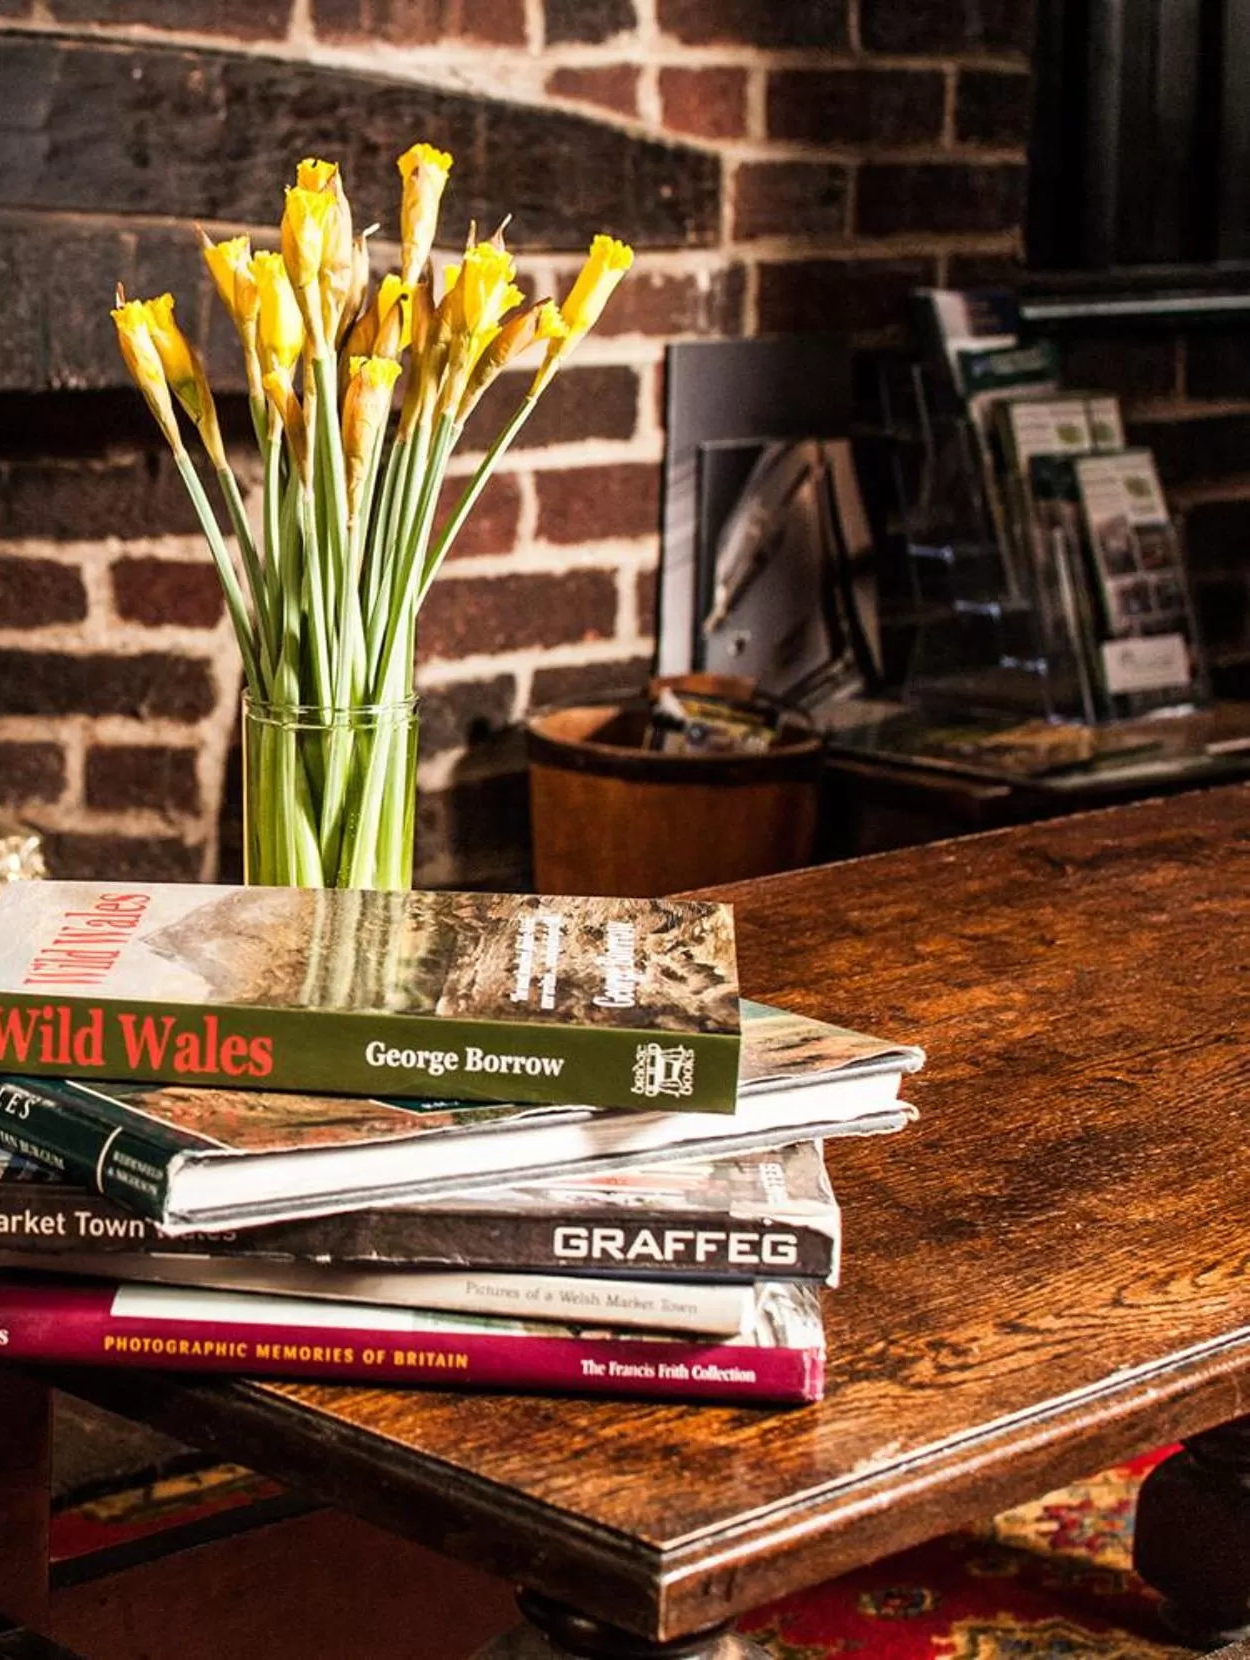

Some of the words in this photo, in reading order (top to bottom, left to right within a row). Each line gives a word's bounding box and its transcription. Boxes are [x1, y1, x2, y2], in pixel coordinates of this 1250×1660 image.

[53, 893, 151, 944] Wales
[23, 949, 121, 984] Wild
[118, 1013, 274, 1077] Wales
[365, 1041, 459, 1077] George
[464, 1047, 565, 1077] Borrow
[74, 1211, 146, 1239] Town
[553, 1226, 798, 1265] GRAFFEG
[465, 1280, 520, 1301] Pictures
[525, 1286, 540, 1301] of
[560, 1290, 602, 1307] Welsh
[605, 1294, 655, 1311] Market
[661, 1298, 698, 1315] Town
[103, 1335, 248, 1358] PHOTOGRAPHIC
[255, 1343, 354, 1363] MEMORIES
[362, 1349, 386, 1365] OF
[393, 1351, 469, 1369] BRITAIN
[580, 1359, 606, 1376] The
[608, 1361, 656, 1378] Francis
[658, 1363, 690, 1380] Frith
[691, 1365, 757, 1383] Collection
